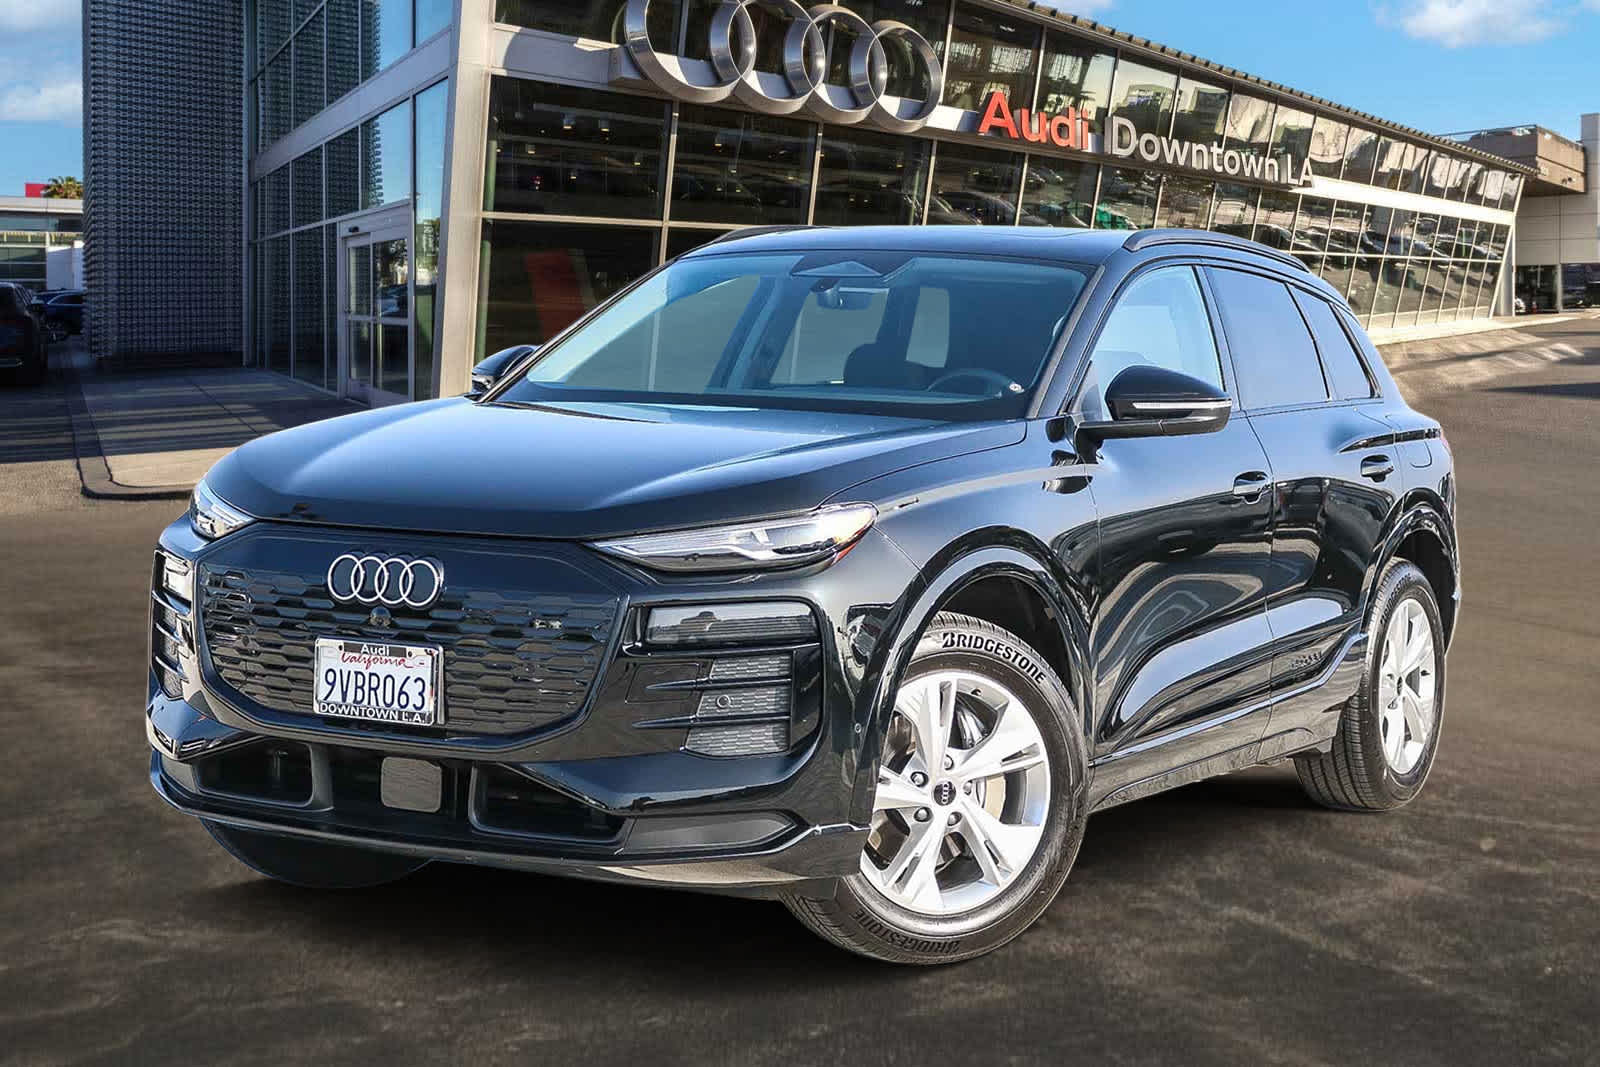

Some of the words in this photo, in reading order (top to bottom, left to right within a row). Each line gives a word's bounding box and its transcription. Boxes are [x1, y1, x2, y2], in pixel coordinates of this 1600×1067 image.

[978, 91, 1089, 151] Audi
[1105, 116, 1279, 184] Downtown
[1286, 154, 1315, 187] LA
[361, 644, 390, 656] Audi
[942, 632, 1046, 684] BRIDGESTONE
[323, 668, 426, 711] 9VBR063
[320, 703, 399, 720] DOWNTOWN
